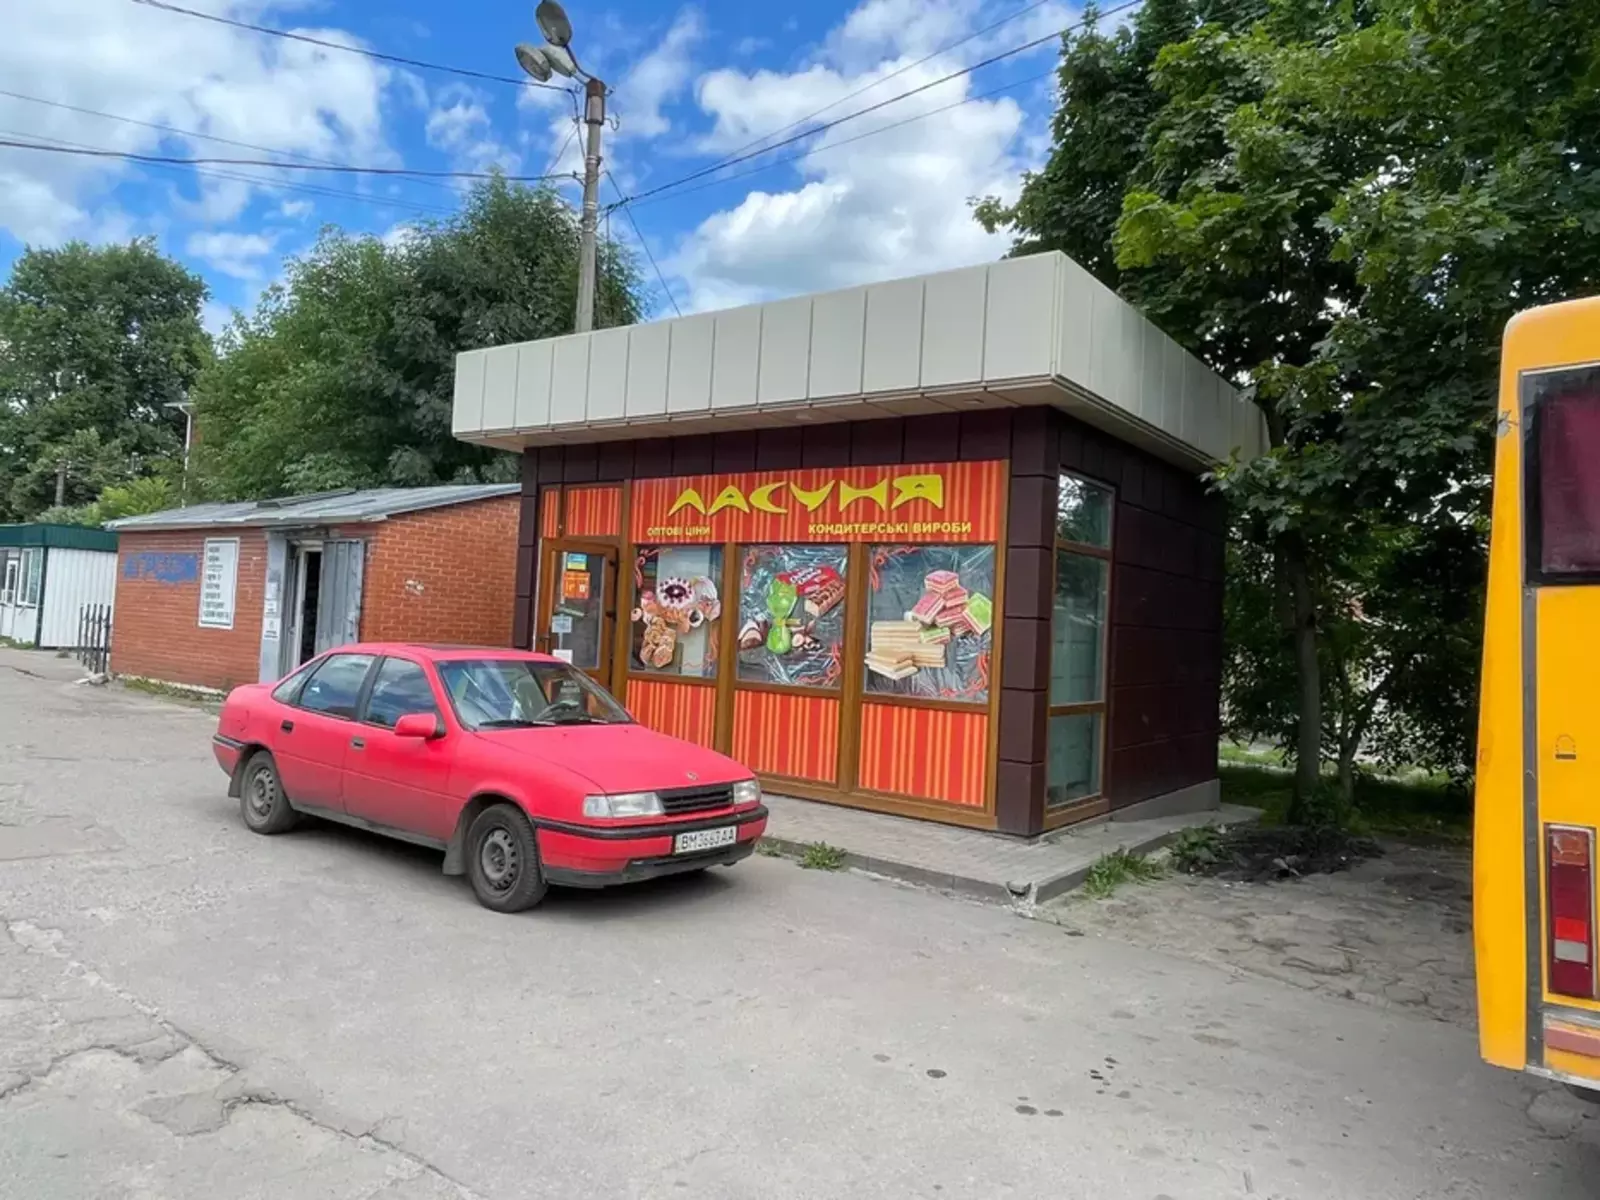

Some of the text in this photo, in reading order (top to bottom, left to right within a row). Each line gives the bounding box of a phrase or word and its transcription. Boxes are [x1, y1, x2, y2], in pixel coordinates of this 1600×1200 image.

[667, 474, 944, 517] ЛАСУНЯ
[647, 526, 711, 537] ОПТОВІ ЦІНИ
[808, 522, 972, 535] КОНДИТЕРСЬКІ ВИРОБИ
